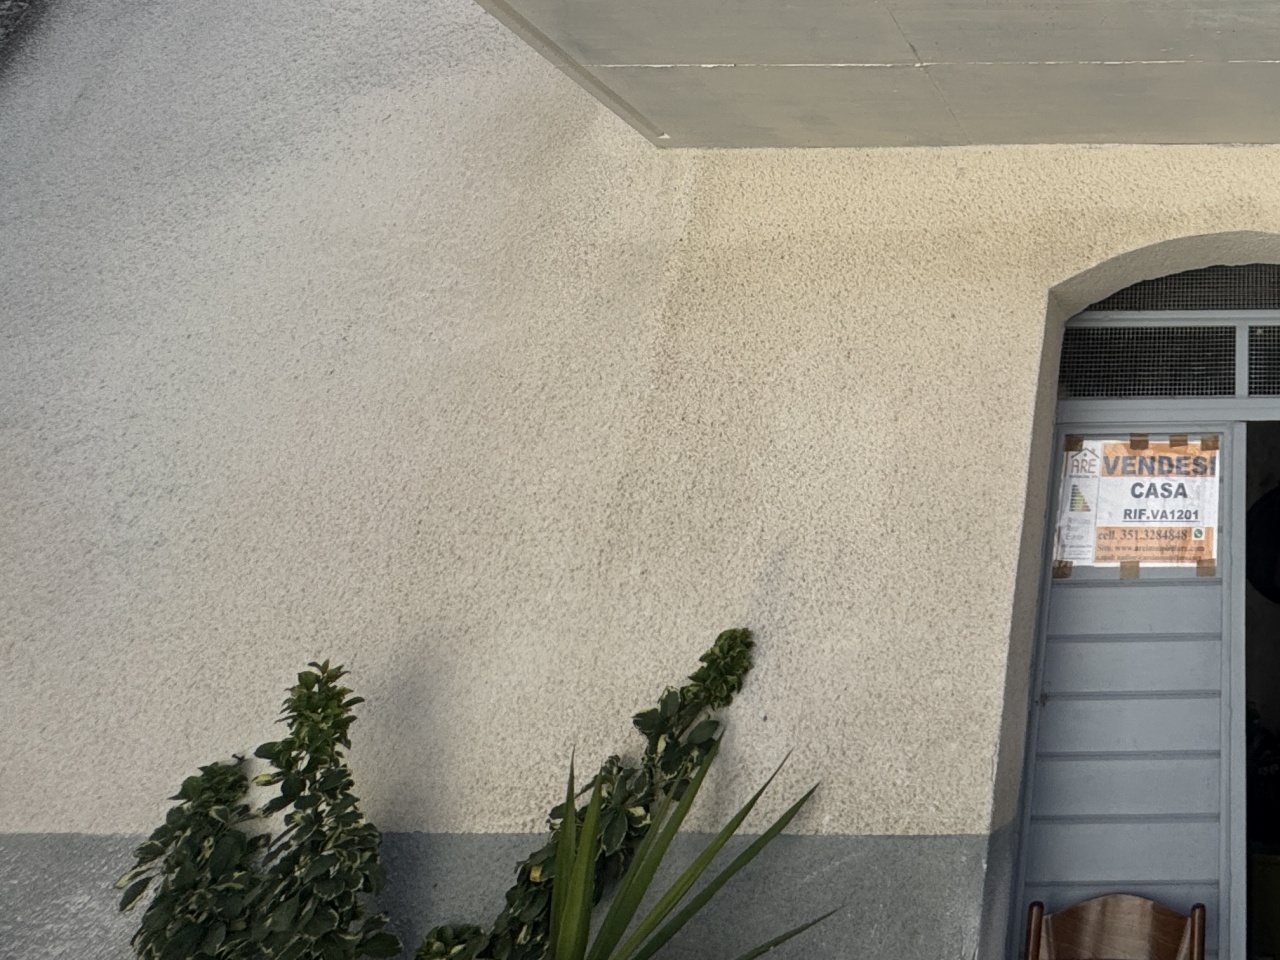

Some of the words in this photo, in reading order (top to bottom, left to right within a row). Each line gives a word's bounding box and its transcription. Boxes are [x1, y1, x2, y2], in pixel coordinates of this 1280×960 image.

[1071, 459, 1096, 474] ARE
[1102, 455, 1217, 476] VENDESI
[1130, 483, 1188, 499] CASA
[1123, 509, 1200, 520] RIF.VA1201
[1120, 529, 1188, 541] 351.3284848
